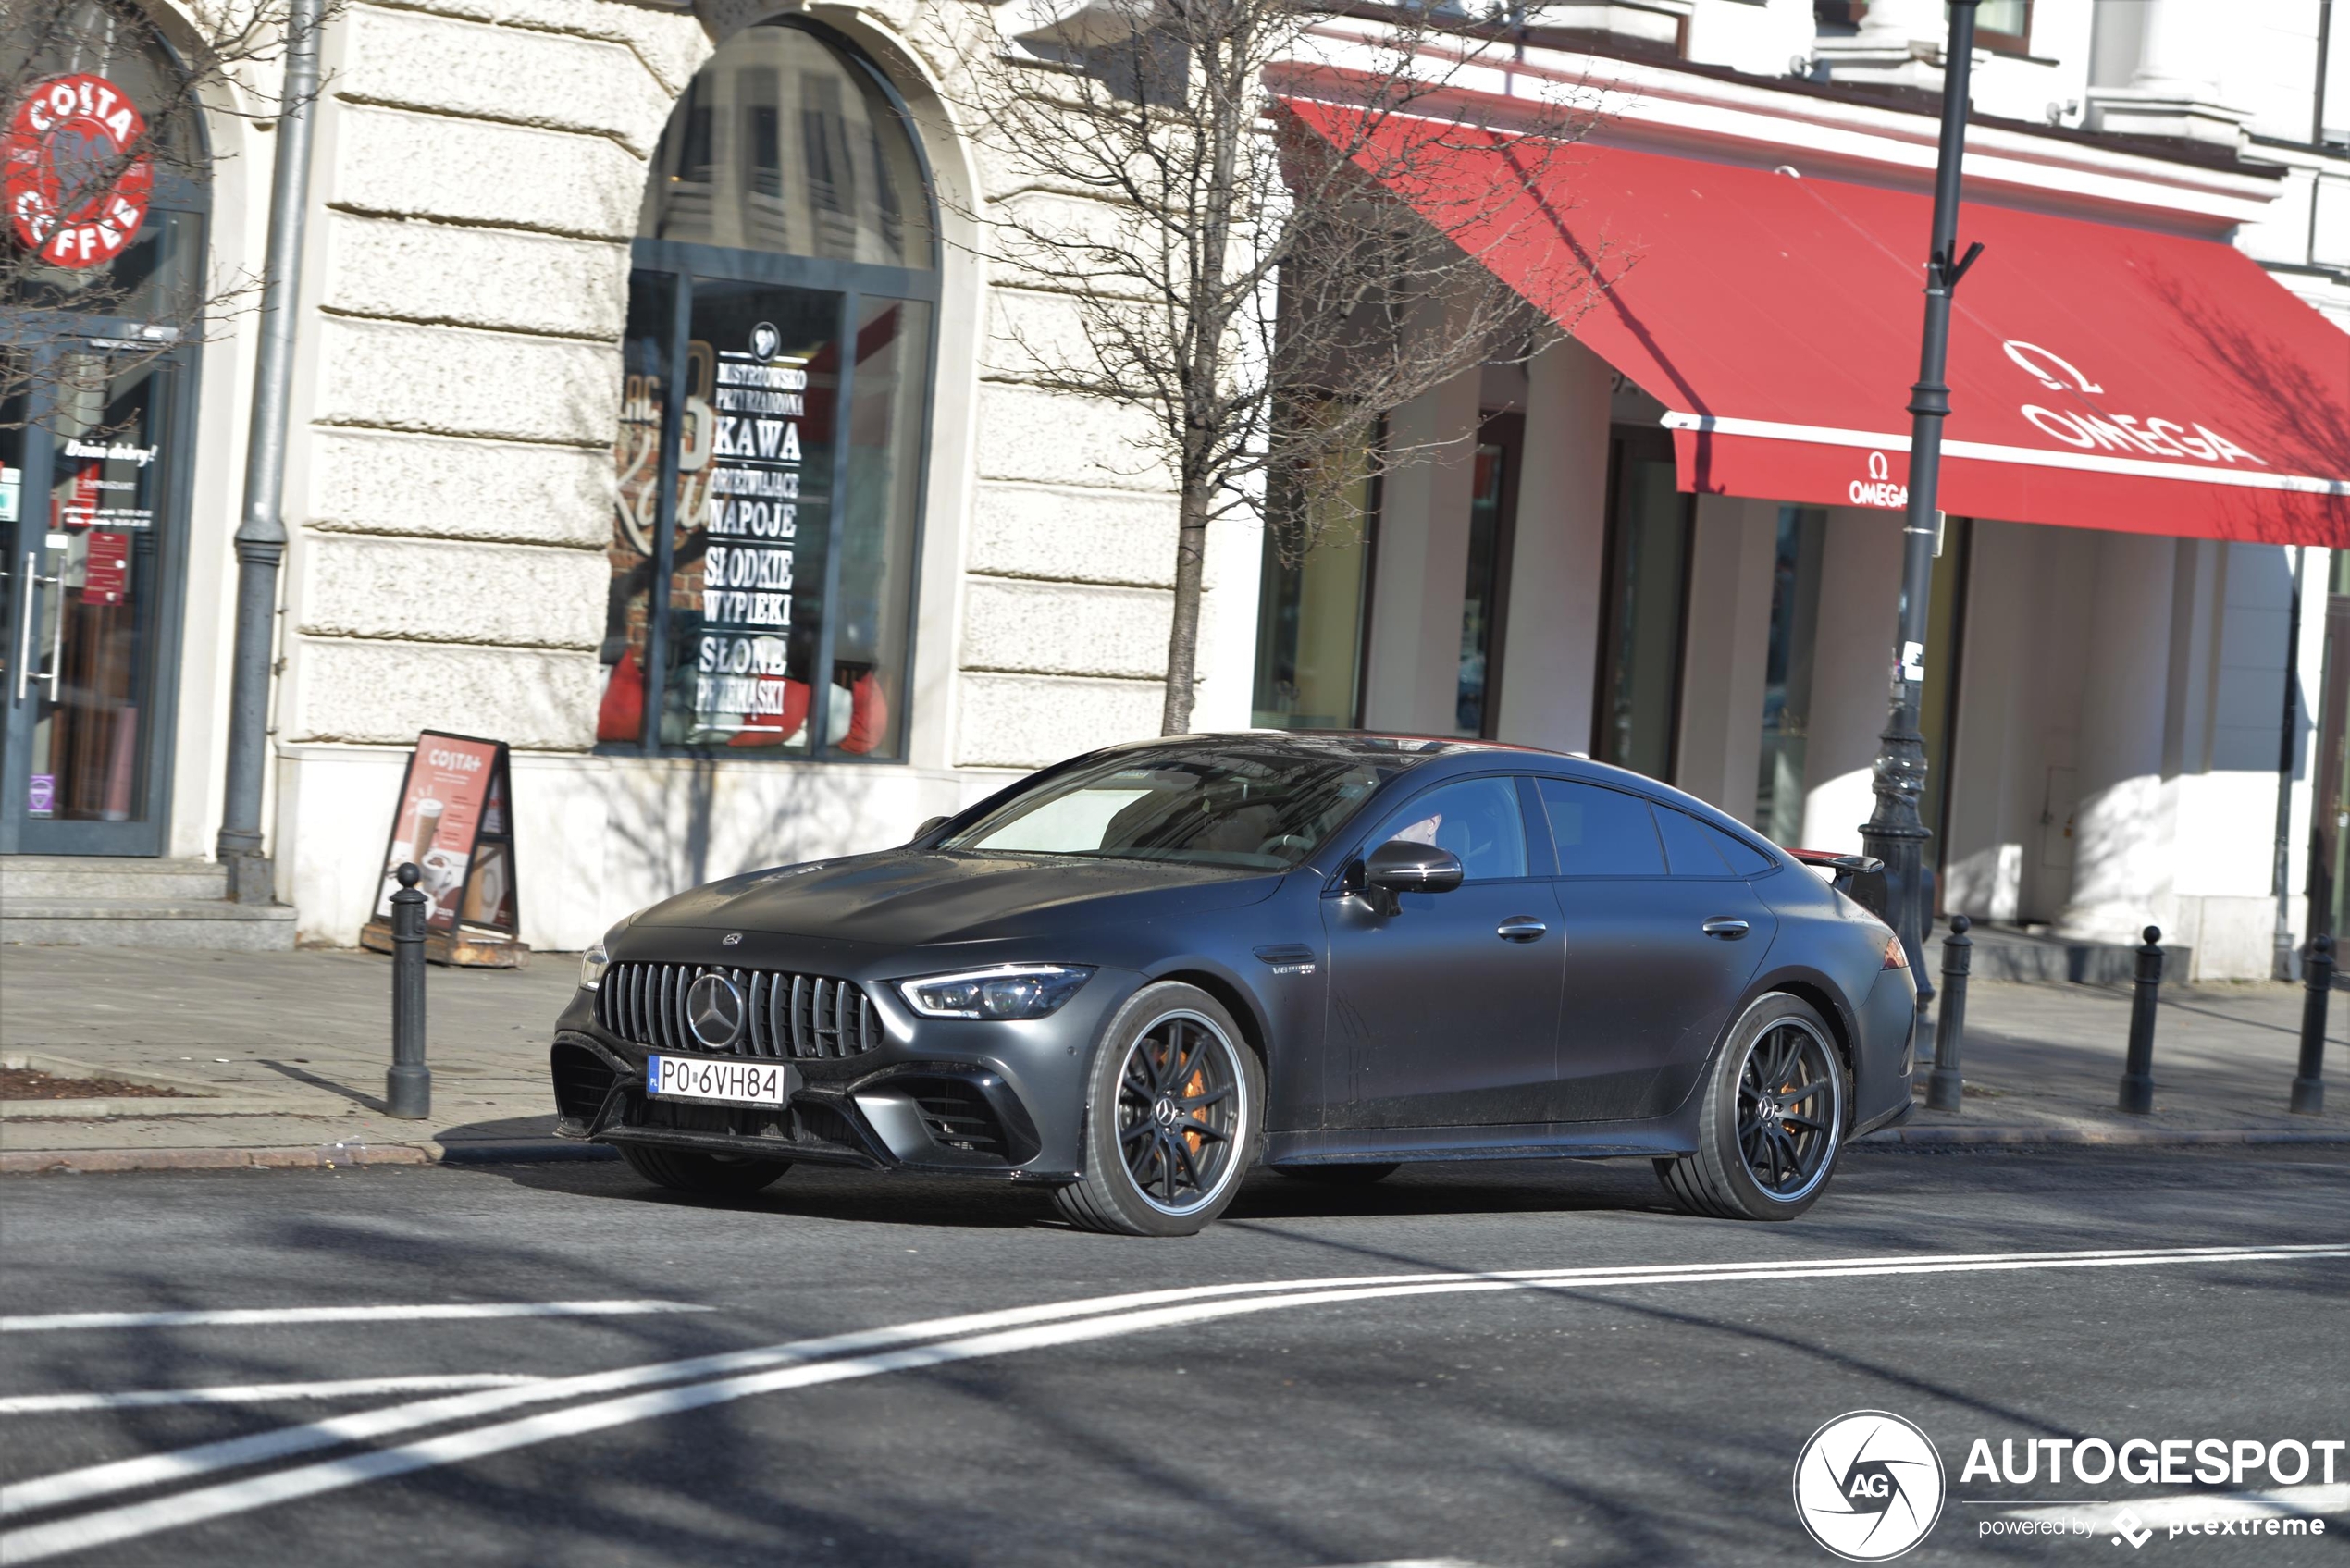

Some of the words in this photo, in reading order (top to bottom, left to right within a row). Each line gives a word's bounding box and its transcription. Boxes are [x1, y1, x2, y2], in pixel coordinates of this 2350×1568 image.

[30, 81, 134, 142] COSTA
[17, 190, 140, 260] COFFEE
[717, 362, 808, 390] MISTRZOWSKO
[712, 416, 802, 460] KAWA
[2021, 404, 2270, 465] OMEGA
[1849, 479, 1909, 508] OMEGA
[707, 499, 797, 537] NAPOJE
[704, 546, 794, 590] SŁODKIE
[702, 589, 793, 625] WYPIEKI
[699, 636, 787, 676] SŁONE
[695, 677, 786, 722] PRZEKĄSKI
[699, 1064, 777, 1099] 6VH84
